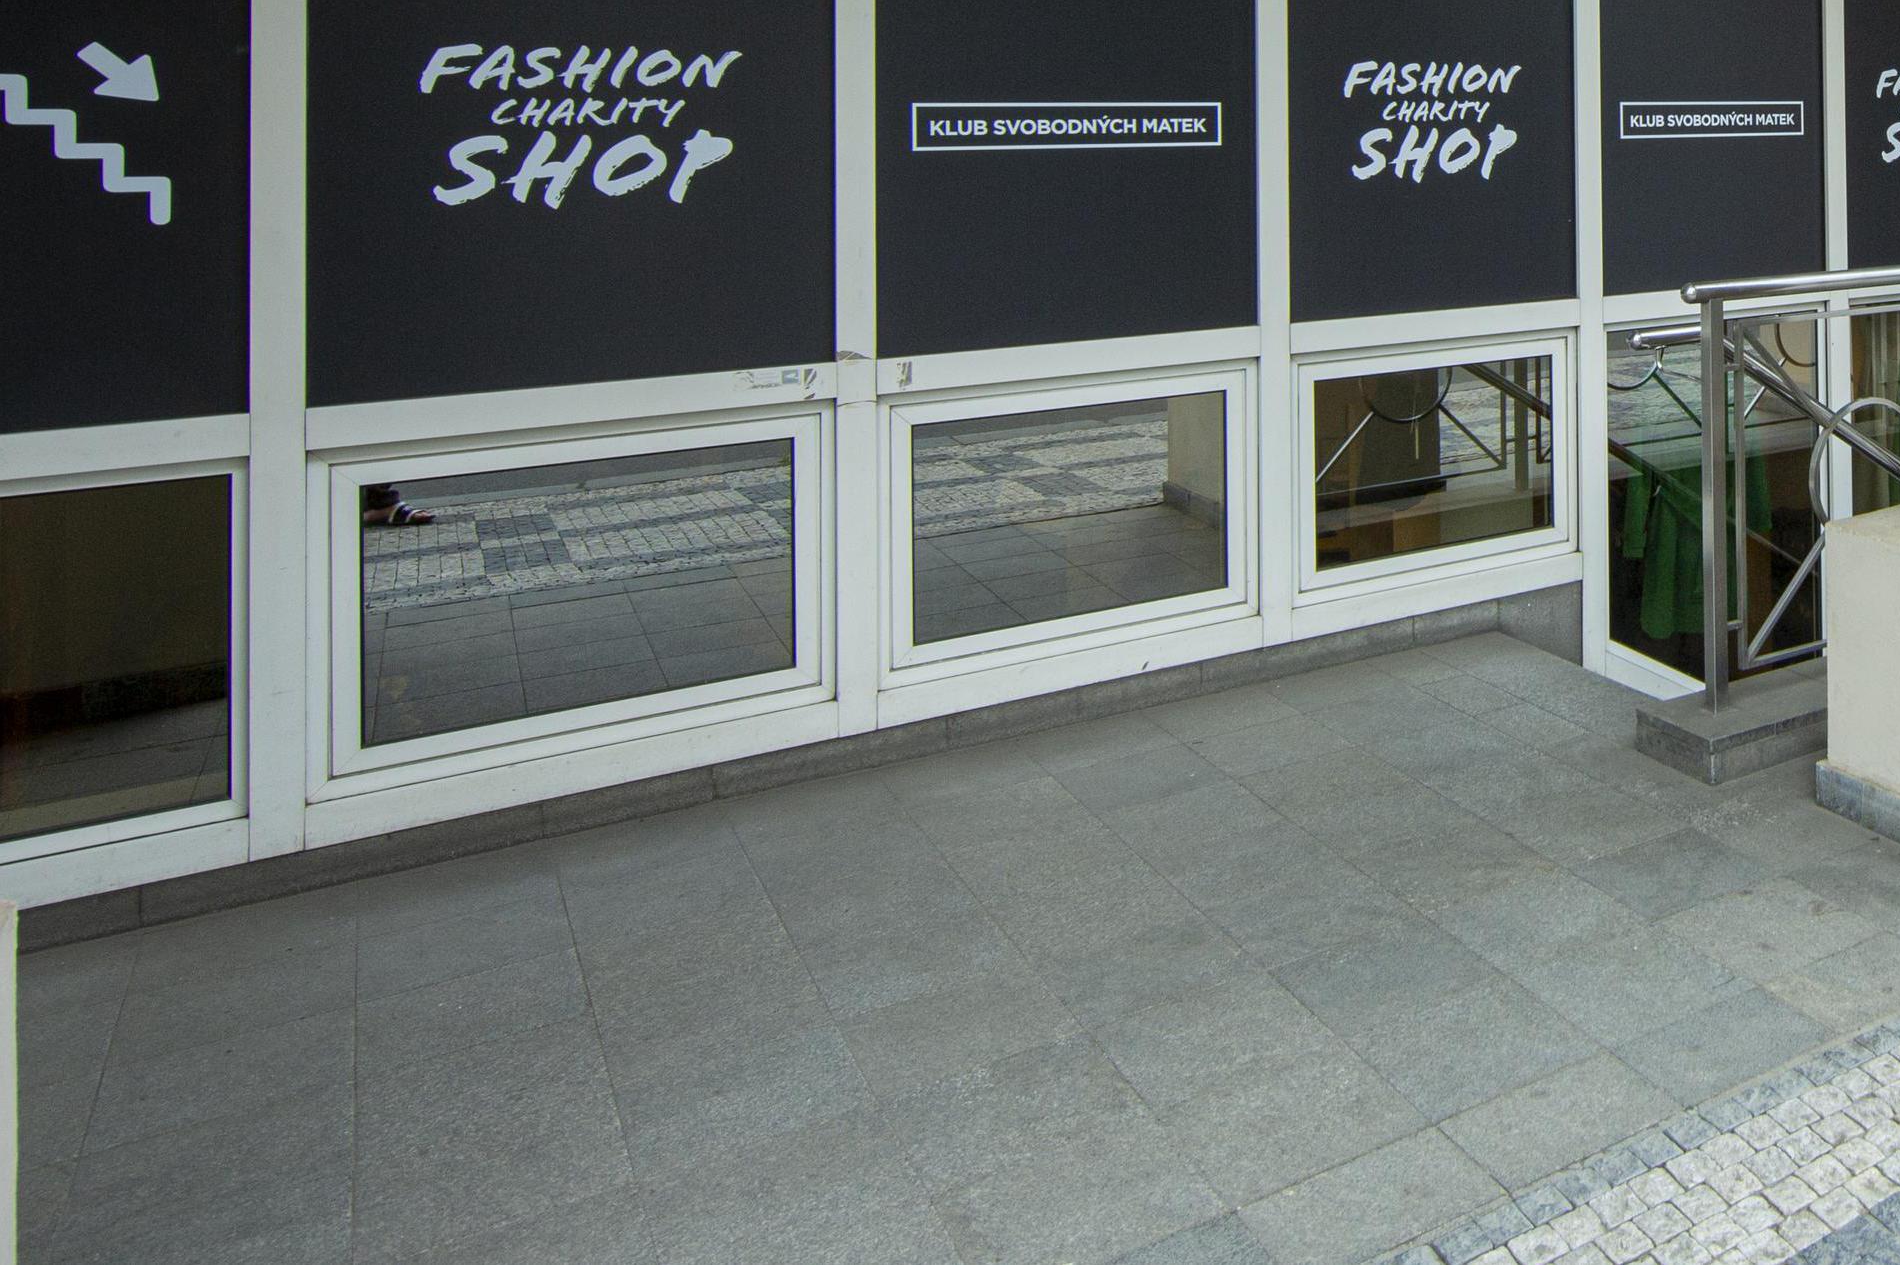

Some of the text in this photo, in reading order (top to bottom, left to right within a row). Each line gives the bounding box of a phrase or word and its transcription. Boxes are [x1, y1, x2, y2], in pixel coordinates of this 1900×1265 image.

[420, 44, 742, 93] FASHION
[1344, 61, 1521, 98] FASHION
[491, 97, 685, 127] CHARITY
[929, 115, 1207, 137] KLUB SVOBODNÝCH MATEK
[1383, 99, 1490, 123] CHARITY
[1630, 111, 1795, 128] KLUB SVOBODNÝCH MATEK
[433, 129, 733, 209] SHOP
[1352, 124, 1517, 183] SHOP
